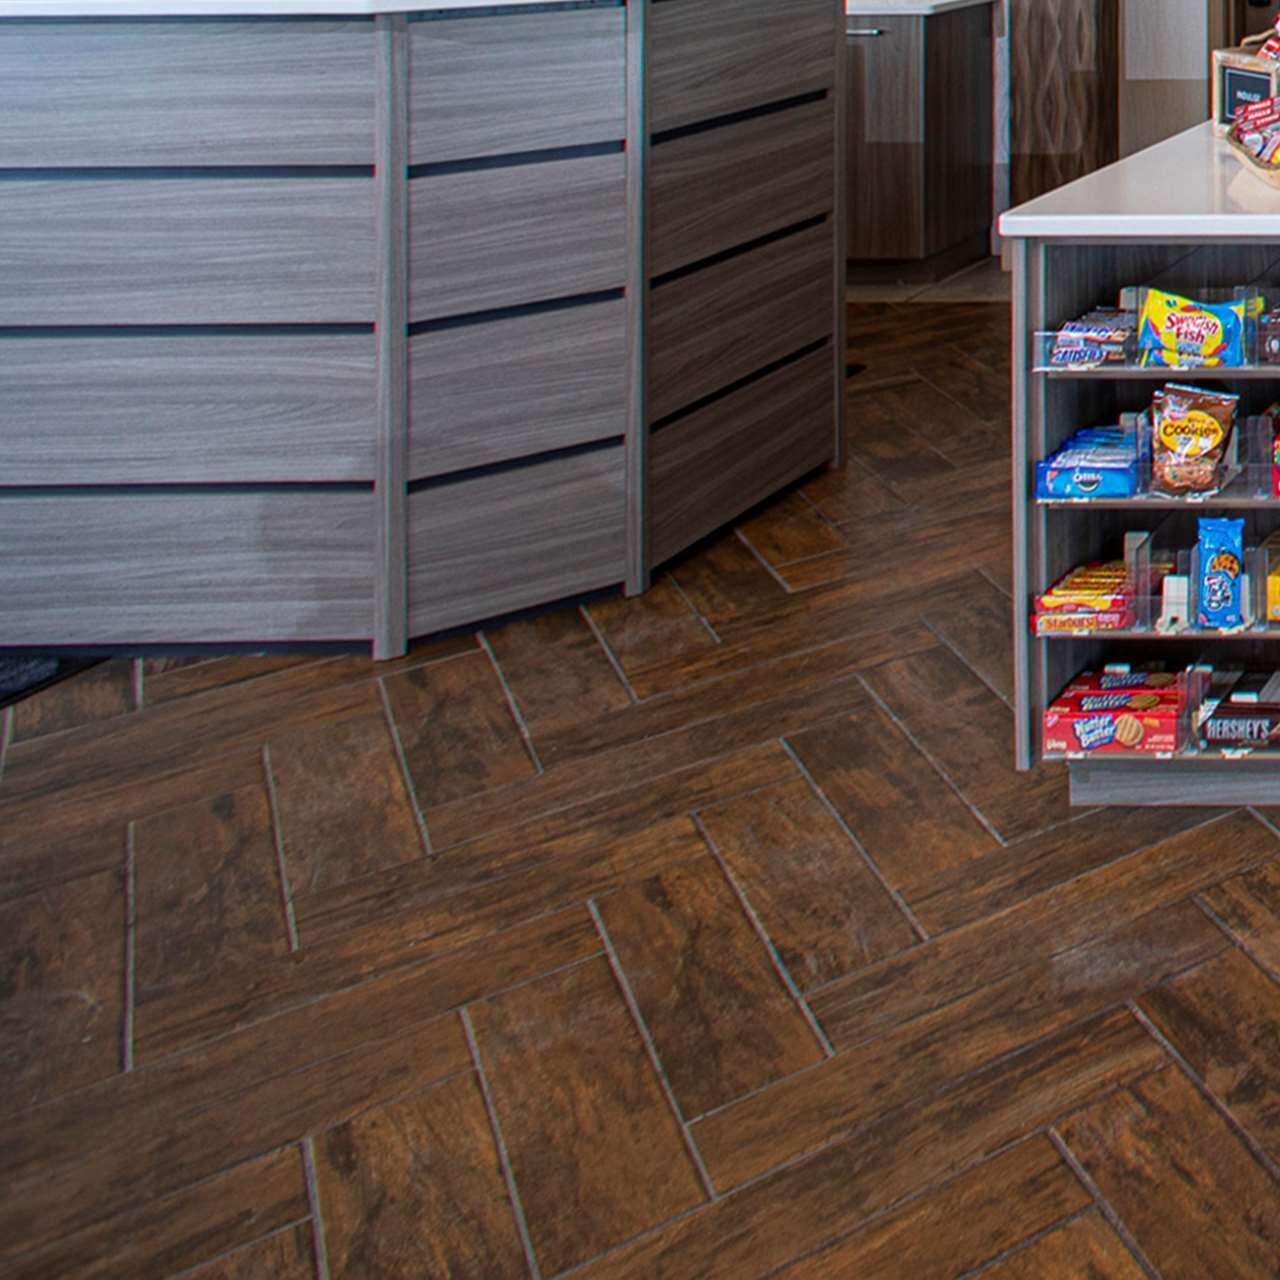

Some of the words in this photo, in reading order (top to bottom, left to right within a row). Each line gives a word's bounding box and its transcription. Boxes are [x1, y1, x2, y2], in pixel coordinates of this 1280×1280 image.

[1166, 311, 1219, 336] Swedish
[1175, 326, 1206, 344] Fish
[1162, 423, 1219, 438] Cookies
[1074, 714, 1113, 735] Nutter
[1206, 718, 1270, 740] HERSHEY'S
[1081, 724, 1116, 749] Butter
